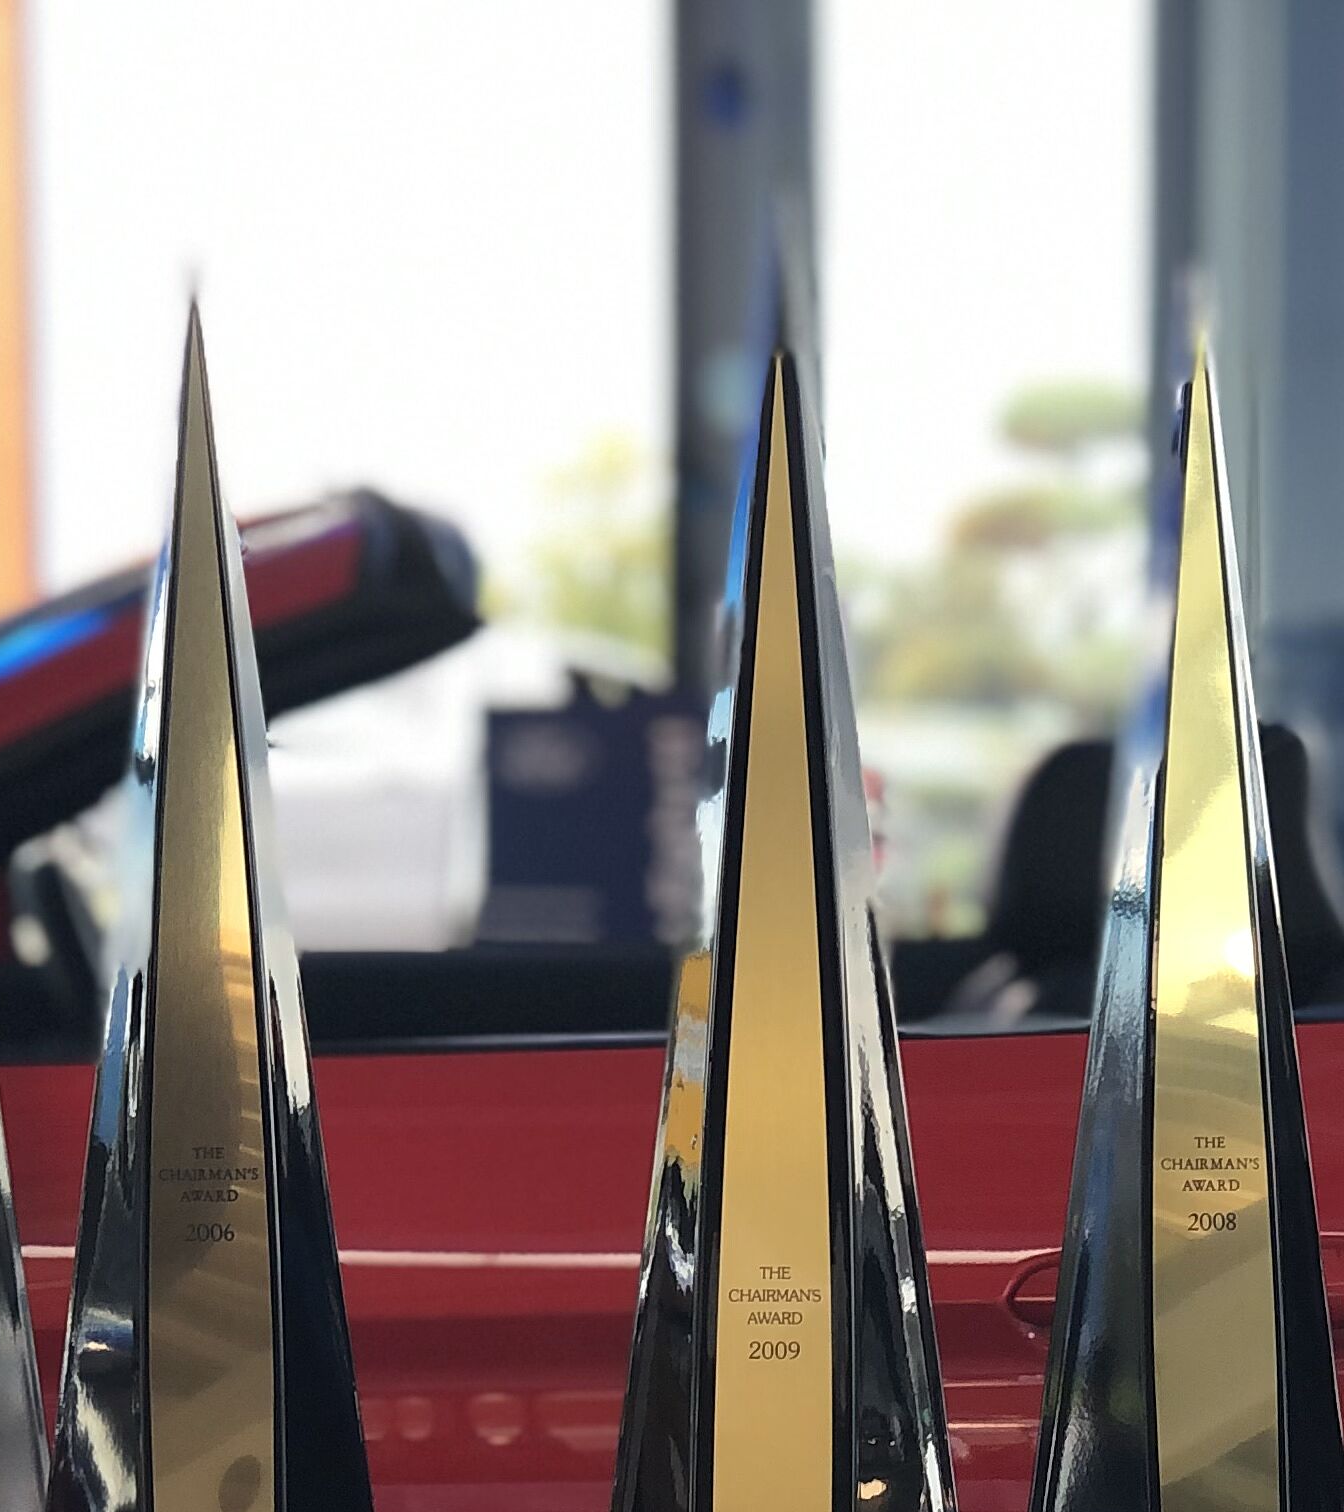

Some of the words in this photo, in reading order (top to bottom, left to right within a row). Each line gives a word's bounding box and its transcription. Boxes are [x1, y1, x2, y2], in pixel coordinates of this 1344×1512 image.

[1194, 1136, 1226, 1149] THE
[192, 1146, 225, 1160] THE
[1160, 1157, 1260, 1171] CHAIRMAN'S
[159, 1167, 259, 1181] CHAIRMAN'S
[1182, 1179, 1240, 1192] AWARD
[180, 1189, 239, 1202] AWARD
[1187, 1212, 1237, 1231] 2008
[184, 1223, 235, 1242] 2006
[759, 1266, 791, 1280] THE
[747, 1311, 803, 1325] AWARD
[748, 1341, 801, 1360] 2009
